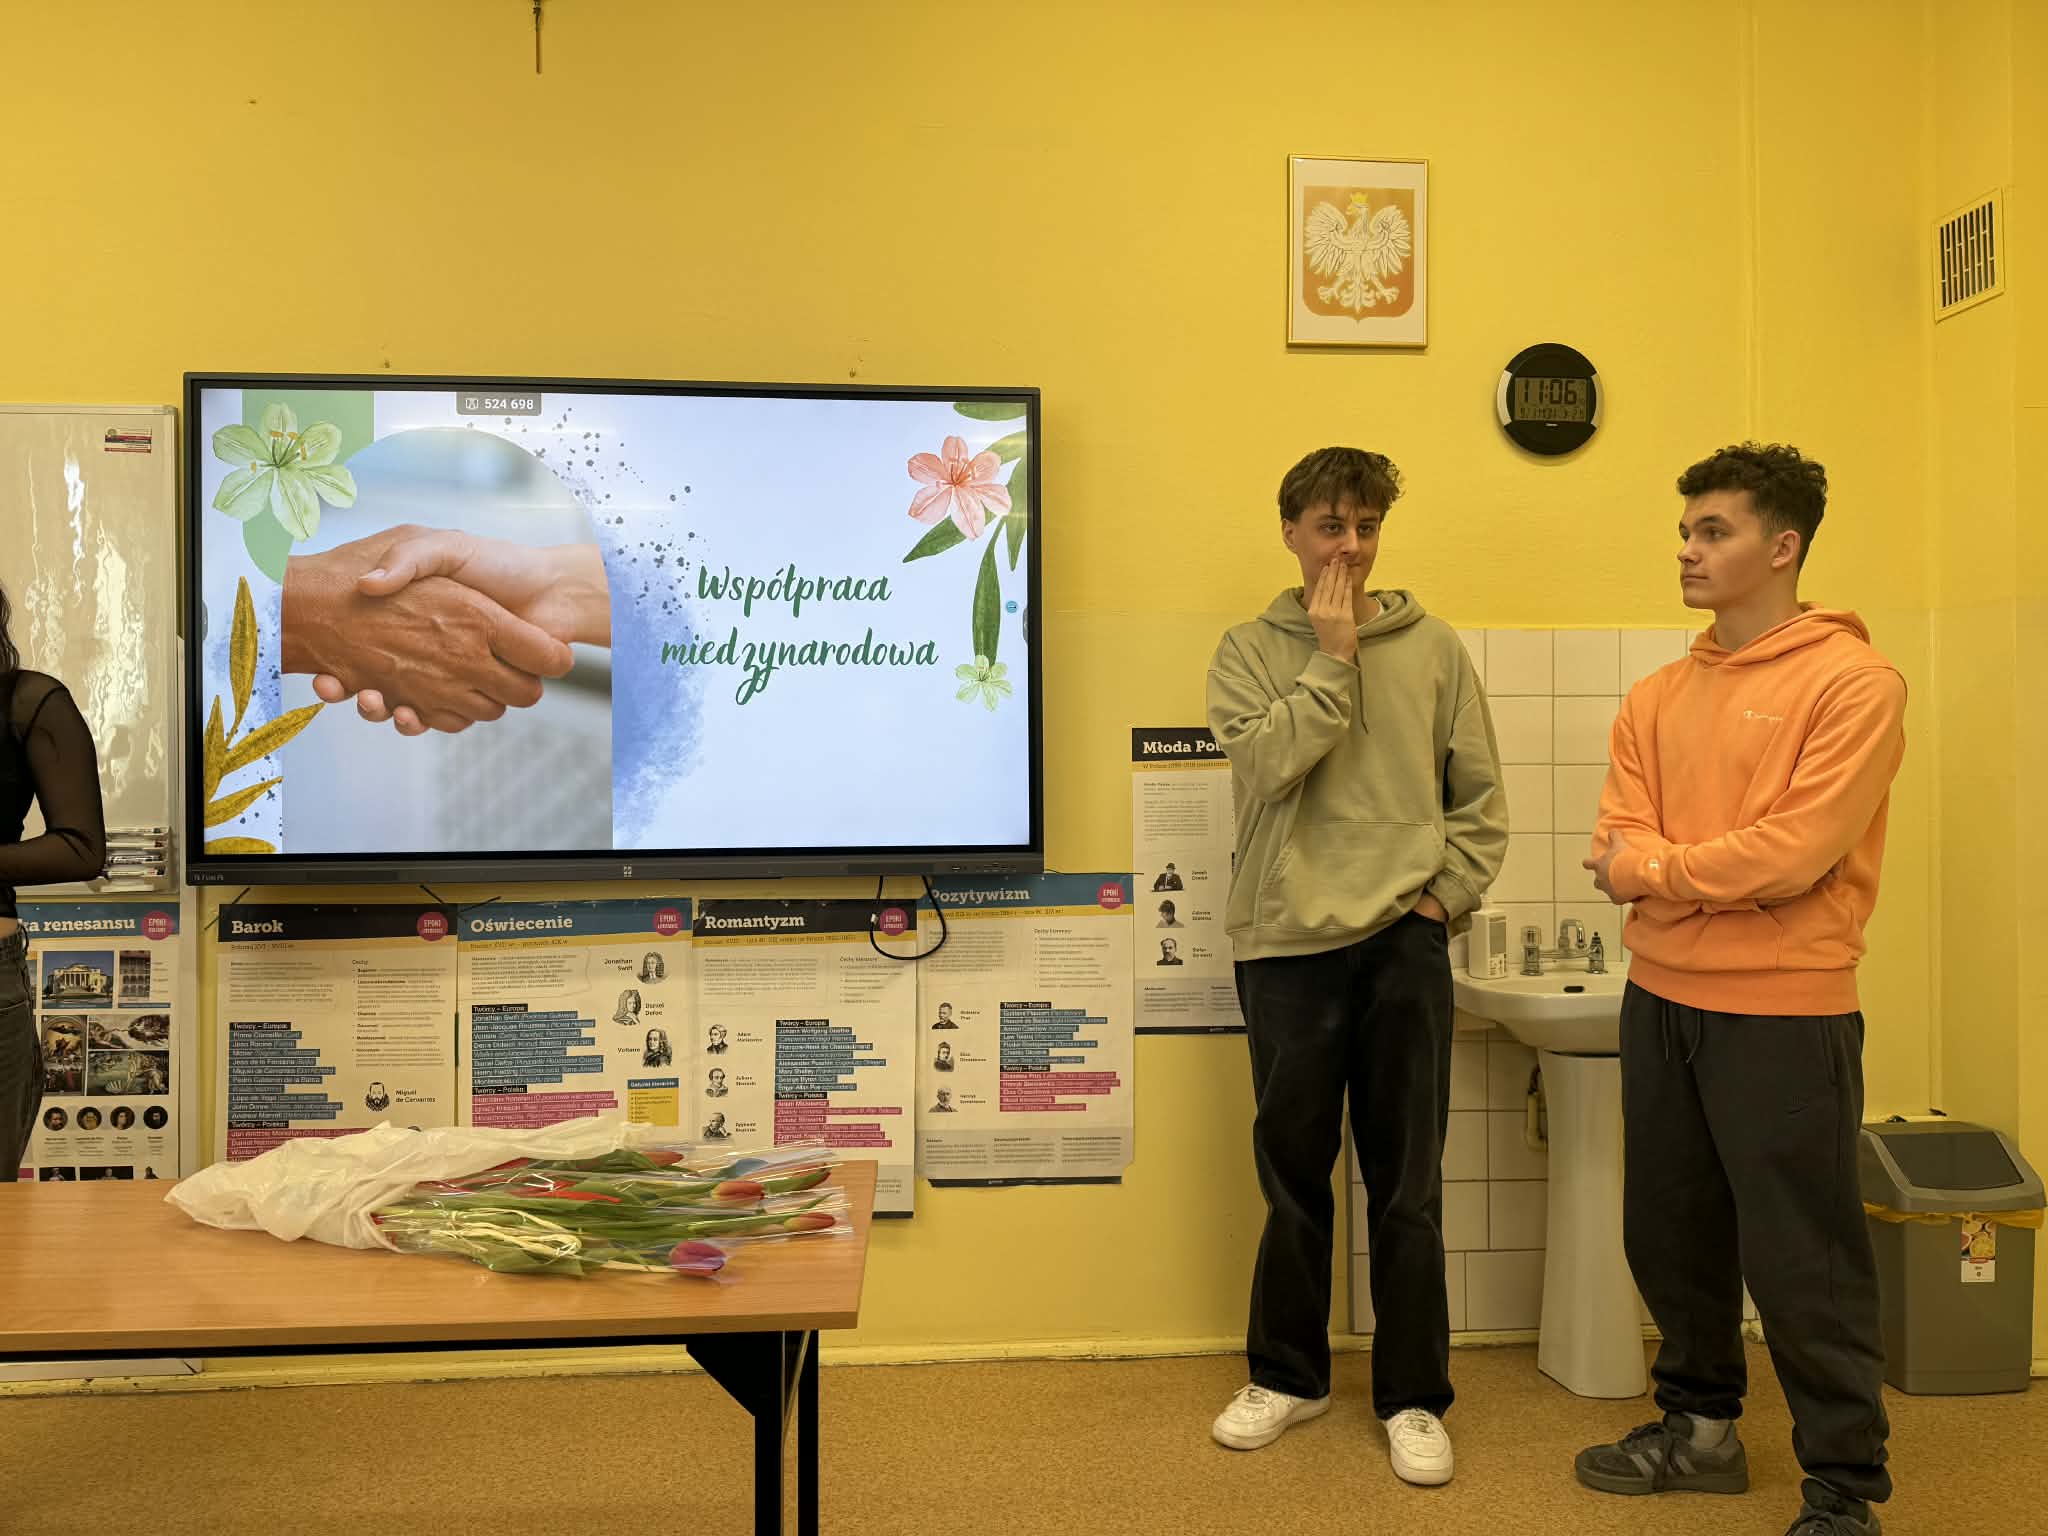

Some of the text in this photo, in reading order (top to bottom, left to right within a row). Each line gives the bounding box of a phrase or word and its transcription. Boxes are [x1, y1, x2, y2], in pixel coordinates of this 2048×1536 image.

[1524, 380, 1577, 404] 11:06
[484, 398, 534, 410] 524 698
[698, 563, 892, 618] Współpraca
[661, 626, 939, 705] miedzynarodowa
[1143, 740, 1192, 754] Młoda
[43, 918, 136, 932] renesansu
[231, 919, 284, 934] Barok
[470, 915, 573, 933] Oświecenie
[705, 914, 805, 931] Romantyzm
